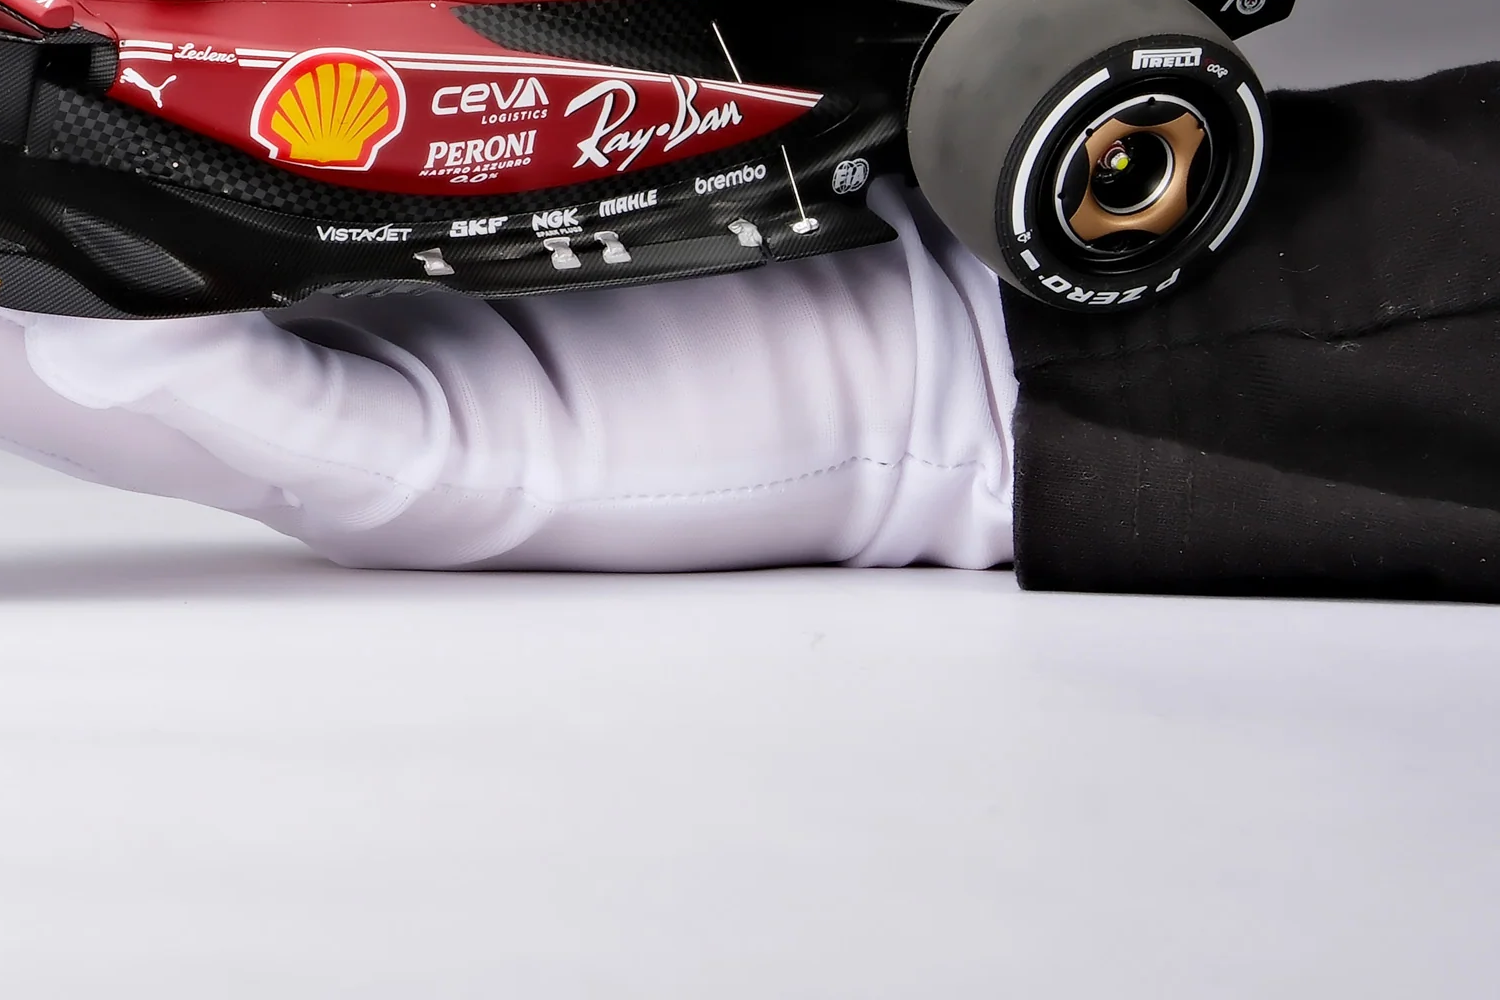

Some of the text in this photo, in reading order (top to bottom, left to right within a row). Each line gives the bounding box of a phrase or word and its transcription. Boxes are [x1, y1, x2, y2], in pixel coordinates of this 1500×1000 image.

[174, 42, 238, 64] Leclerc
[1132, 48, 1202, 69] PIRELLI
[481, 109, 548, 125] LOGISTICS
[424, 130, 537, 169] PERONI
[419, 157, 532, 177] NASTRO AZZURRO
[695, 164, 767, 194] brembo
[833, 163, 866, 190] FIA
[599, 189, 658, 218] MAHLE
[450, 216, 509, 238] SKF
[532, 208, 580, 232] NGK
[1041, 268, 1181, 305] P ZERO
